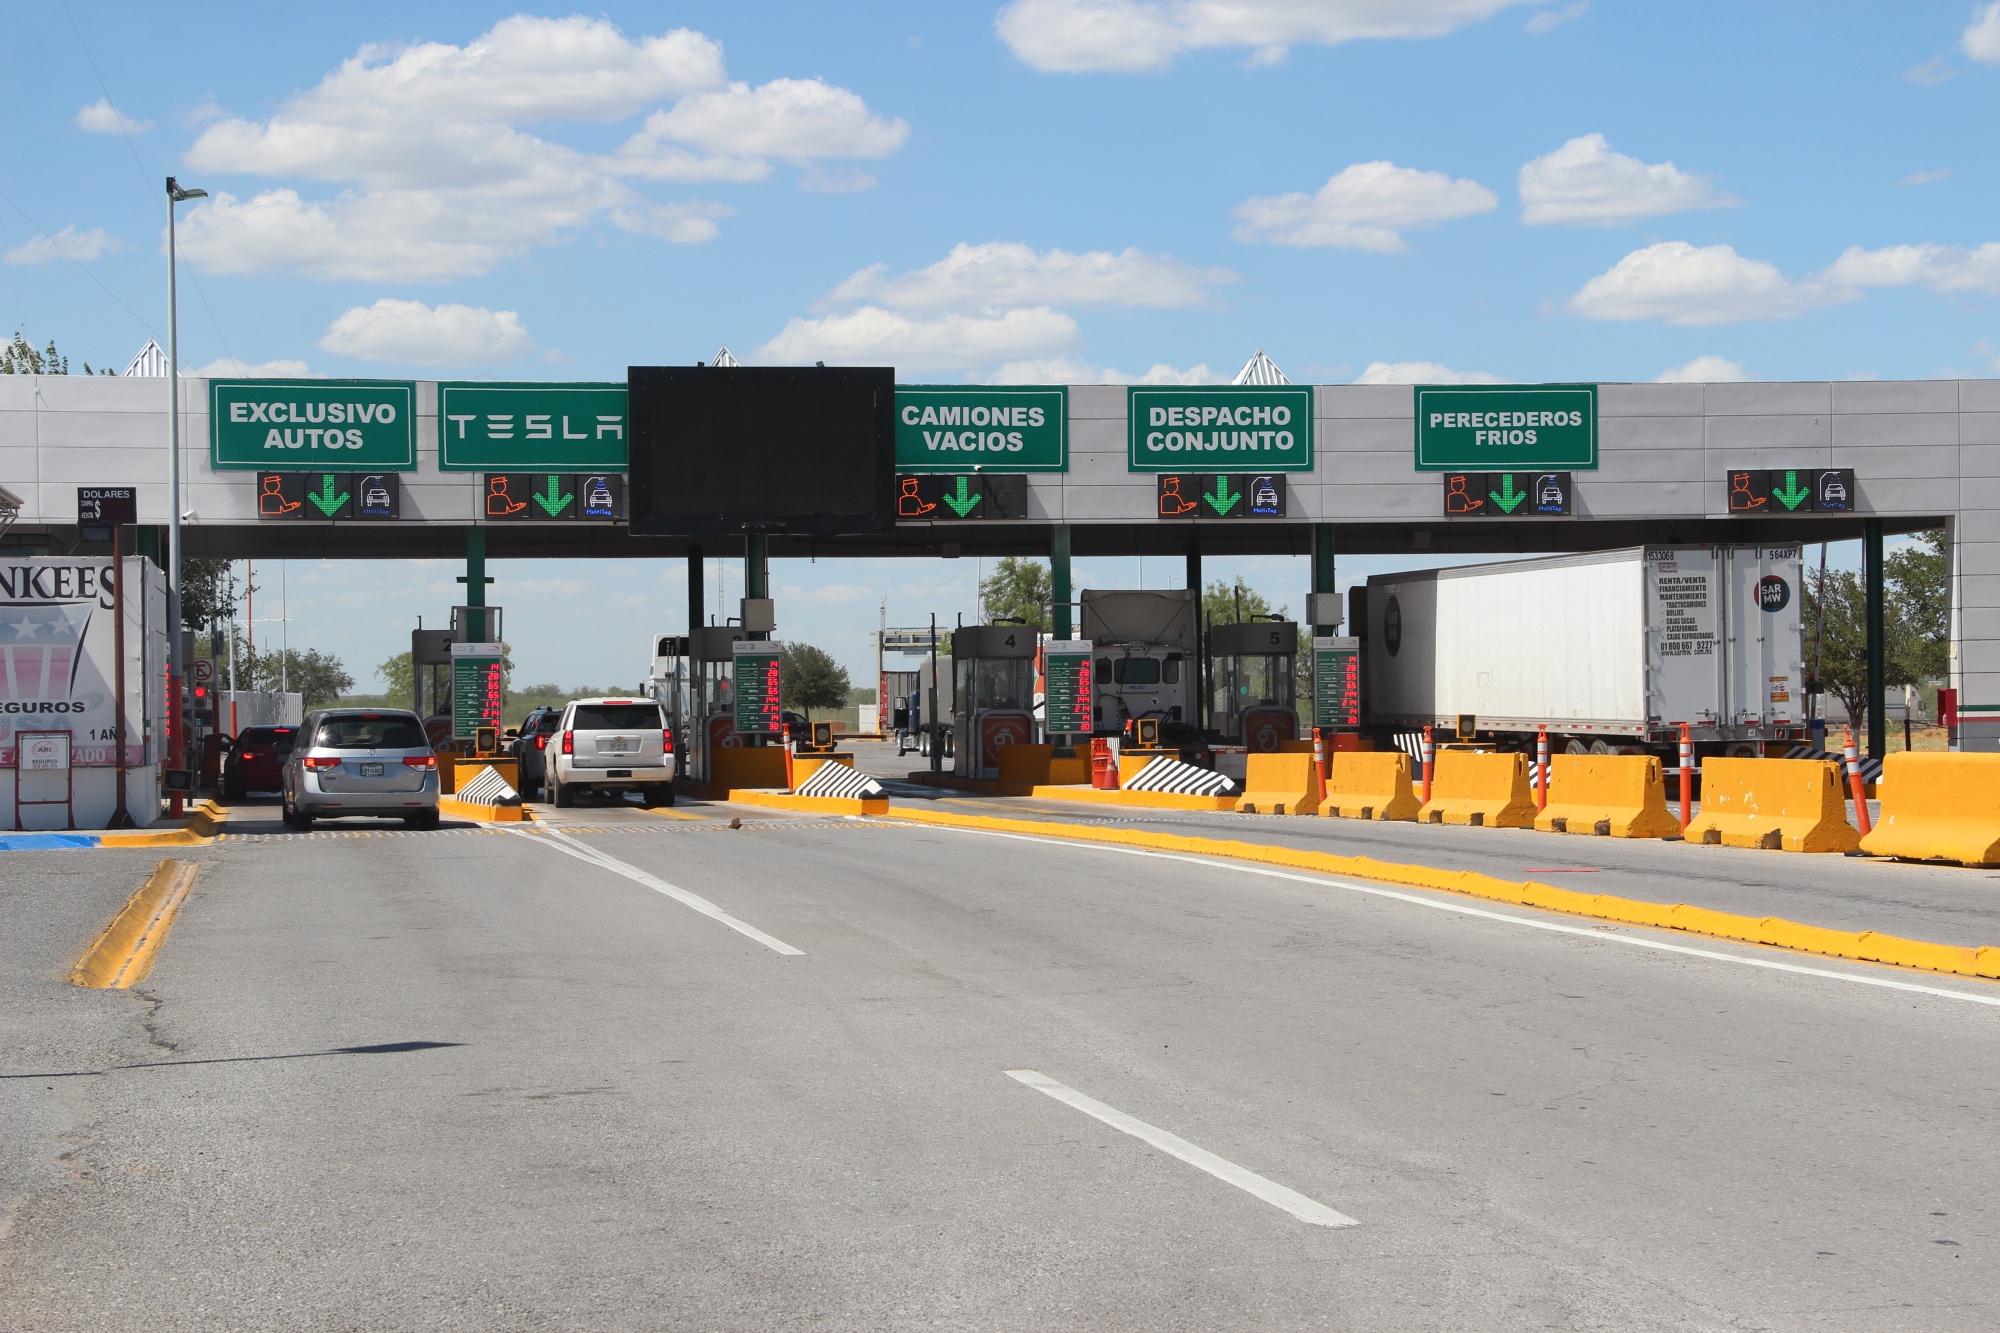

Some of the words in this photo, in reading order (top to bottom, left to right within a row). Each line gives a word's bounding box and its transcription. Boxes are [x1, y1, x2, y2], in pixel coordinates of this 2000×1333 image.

[230, 402, 396, 424] EXCLUSIVO
[901, 405, 1045, 427] CAMIONES
[1149, 405, 1292, 427] DESPACHO
[1430, 411, 1583, 428] PERECEDEROS
[447, 414, 623, 440] TESLA
[263, 428, 364, 449] AUTOS
[922, 431, 1024, 452] VACIOS
[1146, 430, 1295, 452] CONJUNTO
[1475, 429, 1538, 446] FRIOS
[83, 490, 130, 499] DOLARES
[1647, 551, 1675, 561] 1533068
[1659, 577, 1706, 585] RENTA/VENTA
[1761, 583, 1781, 595] SAR
[1763, 594, 1781, 603] MW
[1680, 617, 1696, 625] SECAS
[1270, 632, 1280, 645] 5
[1681, 632, 1715, 640] REFRIGERADAS
[442, 638, 452, 652] 2
[1005, 634, 1016, 648] 4
[1681, 641, 1693, 650] 667
[1696, 641, 1713, 650] 9227
[490, 663, 499, 671] 14
[1346, 664, 1357, 672] 28
[488, 672, 499, 680] 28
[767, 669, 778, 677] 28
[1079, 669, 1090, 677] 28
[1346, 673, 1357, 681] 65
[488, 682, 499, 690] 65
[767, 678, 778, 686] 65
[1079, 678, 1090, 686] 65
[488, 691, 499, 699] 65
[767, 687, 778, 695] 65
[1079, 687, 1090, 695] 65
[1347, 716, 1357, 724] 30
[769, 722, 779, 731] 30
[1080, 722, 1090, 731] 30
[89, 728, 95, 740] 1
